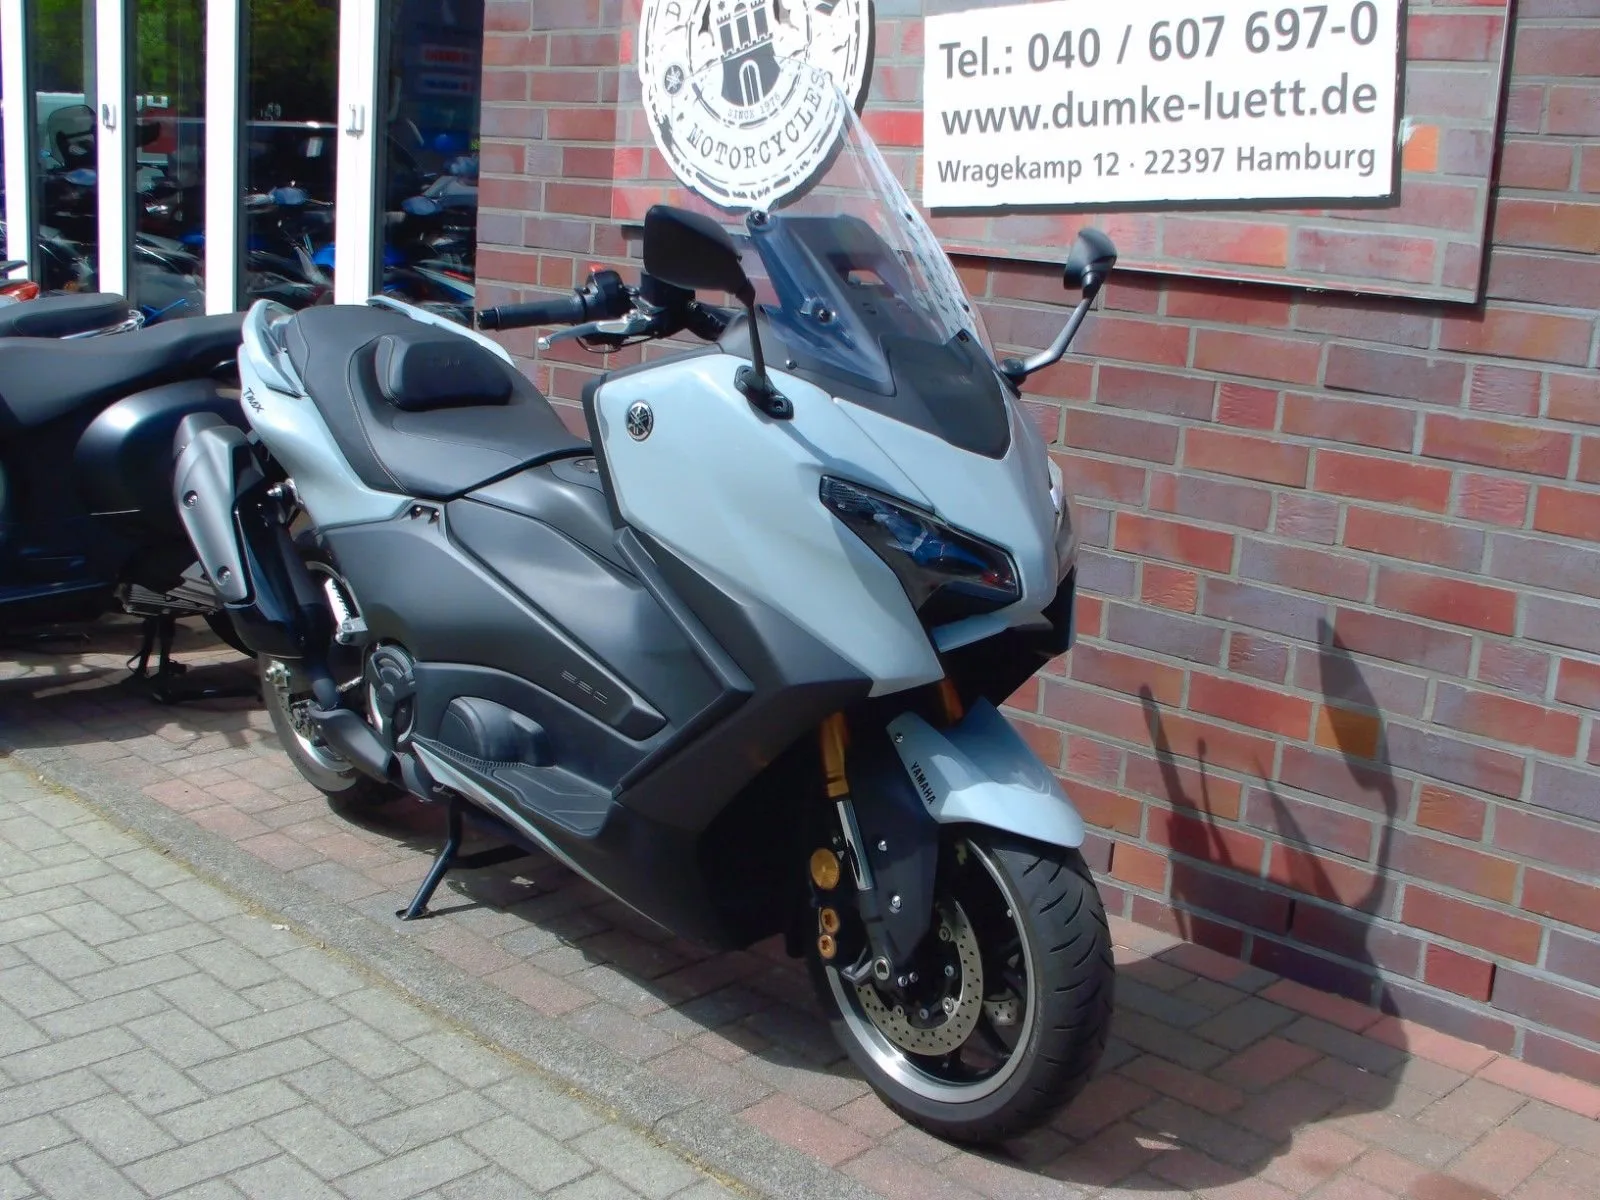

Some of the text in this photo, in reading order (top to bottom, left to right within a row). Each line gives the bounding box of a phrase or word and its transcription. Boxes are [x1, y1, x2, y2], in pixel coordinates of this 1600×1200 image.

[939, 36, 1013, 80] Tel.:
[1027, 27, 1101, 73] 040
[1148, 15, 1226, 62] 607
[1244, 0, 1378, 54] 697-0
[685, 69, 826, 171] MOTORCYCLES
[941, 72, 1378, 136] www.dumke-luett.de
[937, 156, 1083, 189] Wragekamp
[1093, 151, 1121, 178] 12
[1143, 147, 1226, 176] 22397
[1236, 142, 1377, 178] Hamburg
[911, 760, 937, 805] YAMAHA
